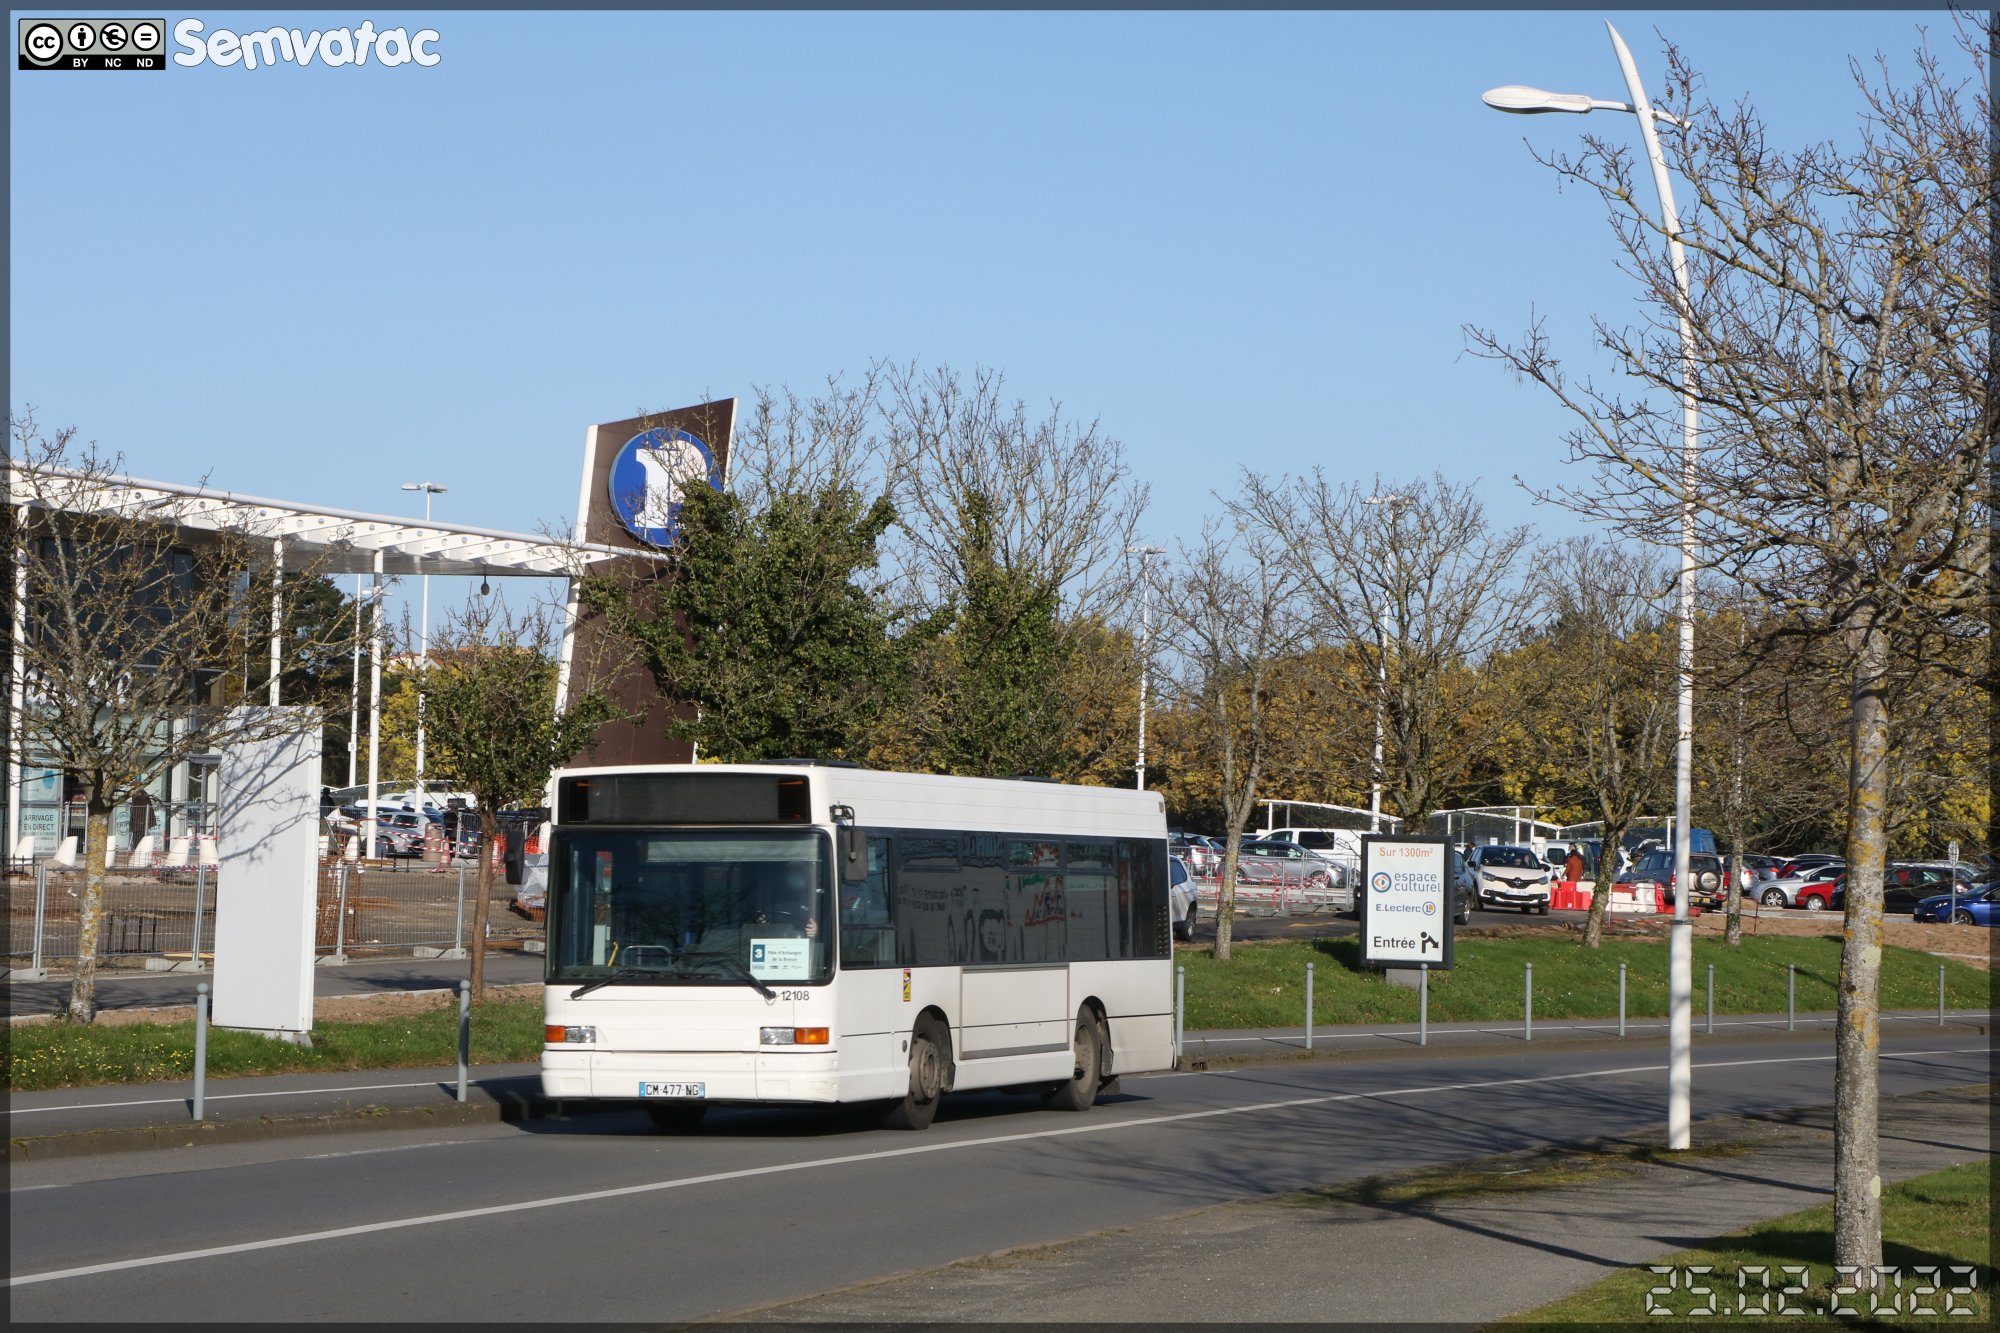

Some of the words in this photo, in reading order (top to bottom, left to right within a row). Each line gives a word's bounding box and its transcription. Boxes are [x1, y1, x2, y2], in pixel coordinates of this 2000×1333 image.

[24, 814, 54, 822] ARRIVAGE
[24, 823, 32, 831] EN
[33, 823, 54, 831] DIRECT
[1379, 847, 1396, 857] Sur
[1394, 872, 1437, 883] espace
[1394, 881, 1442, 892] culturel
[1375, 903, 1421, 913] E.Leclerc
[1373, 936, 1416, 949] Entrée
[754, 948, 763, 959] 3
[780, 990, 810, 1001] 12108
